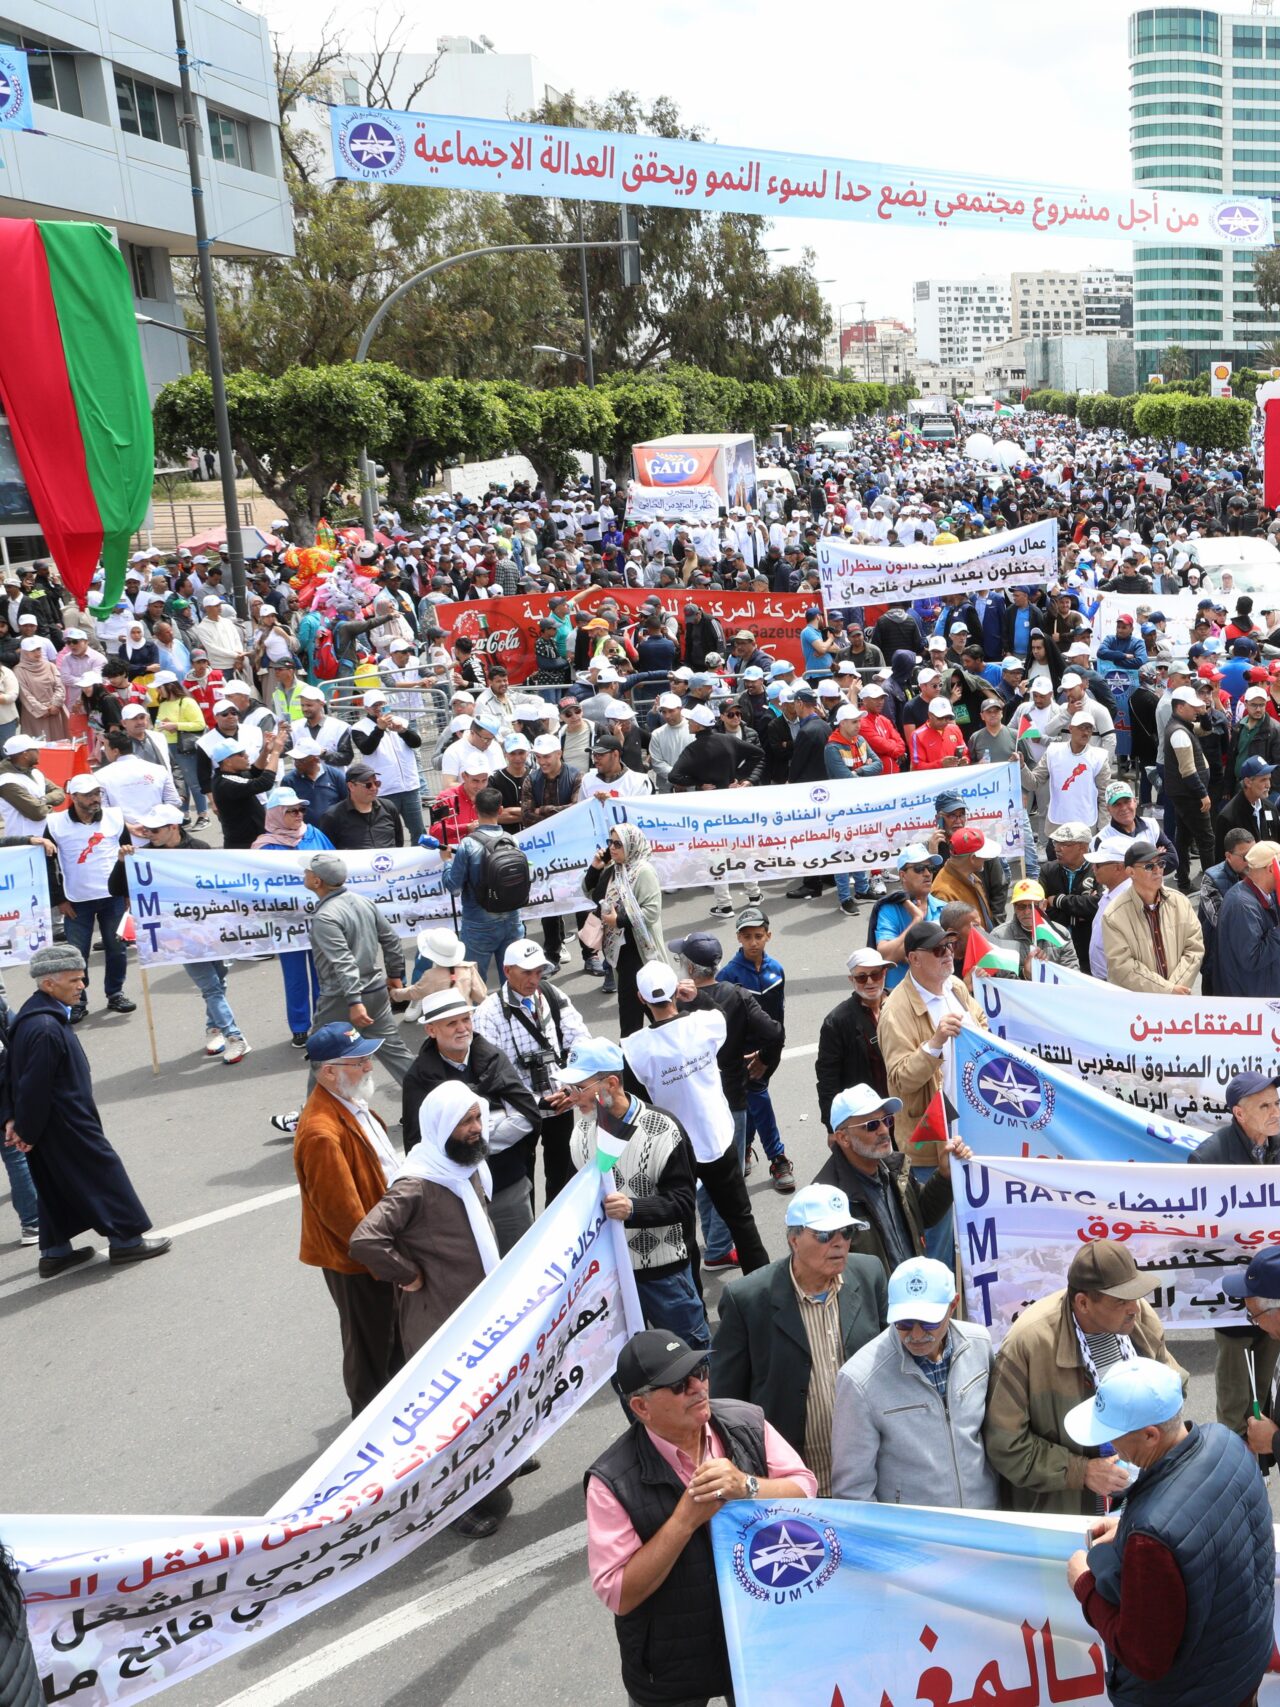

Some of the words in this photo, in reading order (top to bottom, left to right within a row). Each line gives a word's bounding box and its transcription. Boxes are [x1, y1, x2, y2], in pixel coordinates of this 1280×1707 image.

[413, 122, 532, 180] الاجتماعية
[540, 135, 615, 179] العدالة
[362, 169, 388, 178] UMT
[621, 152, 697, 196] ويحقق
[705, 161, 760, 197] النمو
[767, 168, 828, 204] لسوء
[835, 170, 872, 202] حدا
[877, 180, 927, 219] يضع
[934, 192, 1026, 226] مجتمعي
[1117, 193, 1159, 232] أجل
[1032, 195, 1110, 231] مشروع
[1166, 209, 1200, 233] من
[649, 458, 698, 475] GATO
[1019, 538, 1046, 554] عمال
[951, 568, 983, 584] بعيد
[988, 559, 1045, 582] يحتفلون
[840, 582, 865, 605] ماي
[870, 584, 898, 598] فاتح
[773, 806, 821, 830] الفنادق
[826, 795, 897, 825] لمستخدمي
[637, 814, 700, 833] والسياحة
[703, 812, 766, 838] والمطاعم
[843, 822, 882, 844] الفنادق
[650, 840, 675, 853] سطا
[688, 837, 728, 853] البيضاء
[731, 835, 755, 851] الدار
[758, 838, 787, 854] بجهة
[790, 829, 841, 851] والمطاعم
[709, 858, 746, 882] ماي
[754, 855, 796, 874] فاتح
[803, 850, 855, 870] ذكرى
[195, 873, 260, 893] والسياحة
[174, 899, 249, 921] والمشروعة
[252, 896, 299, 914] العادلة
[219, 923, 282, 944] والسياحة
[1130, 1013, 1262, 1042] للمتقاعدين
[1078, 1053, 1136, 1080] المغربي
[1141, 1055, 1211, 1081] الصندوق
[993, 1113, 1028, 1129] UMT
[1174, 1097, 1198, 1123] في
[1107, 1187, 1207, 1219] البيضاء
[564, 1200, 608, 1272] لوكالة
[1077, 1215, 1218, 1243] الحقوق
[457, 1262, 568, 1369] المستقلة
[536, 1259, 600, 1357] متقاعدو
[391, 1368, 462, 1446] للنقل
[431, 1390, 520, 1488] الاتحاد
[393, 1457, 495, 1543] بالعيد
[246, 1481, 421, 1590] المغربي
[117, 1530, 245, 1593] النقل
[774, 1580, 814, 1605] UMT
[51, 1571, 228, 1652] للشغل
[117, 1610, 214, 1679] فاتح
[41, 1669, 98, 1705] ما
